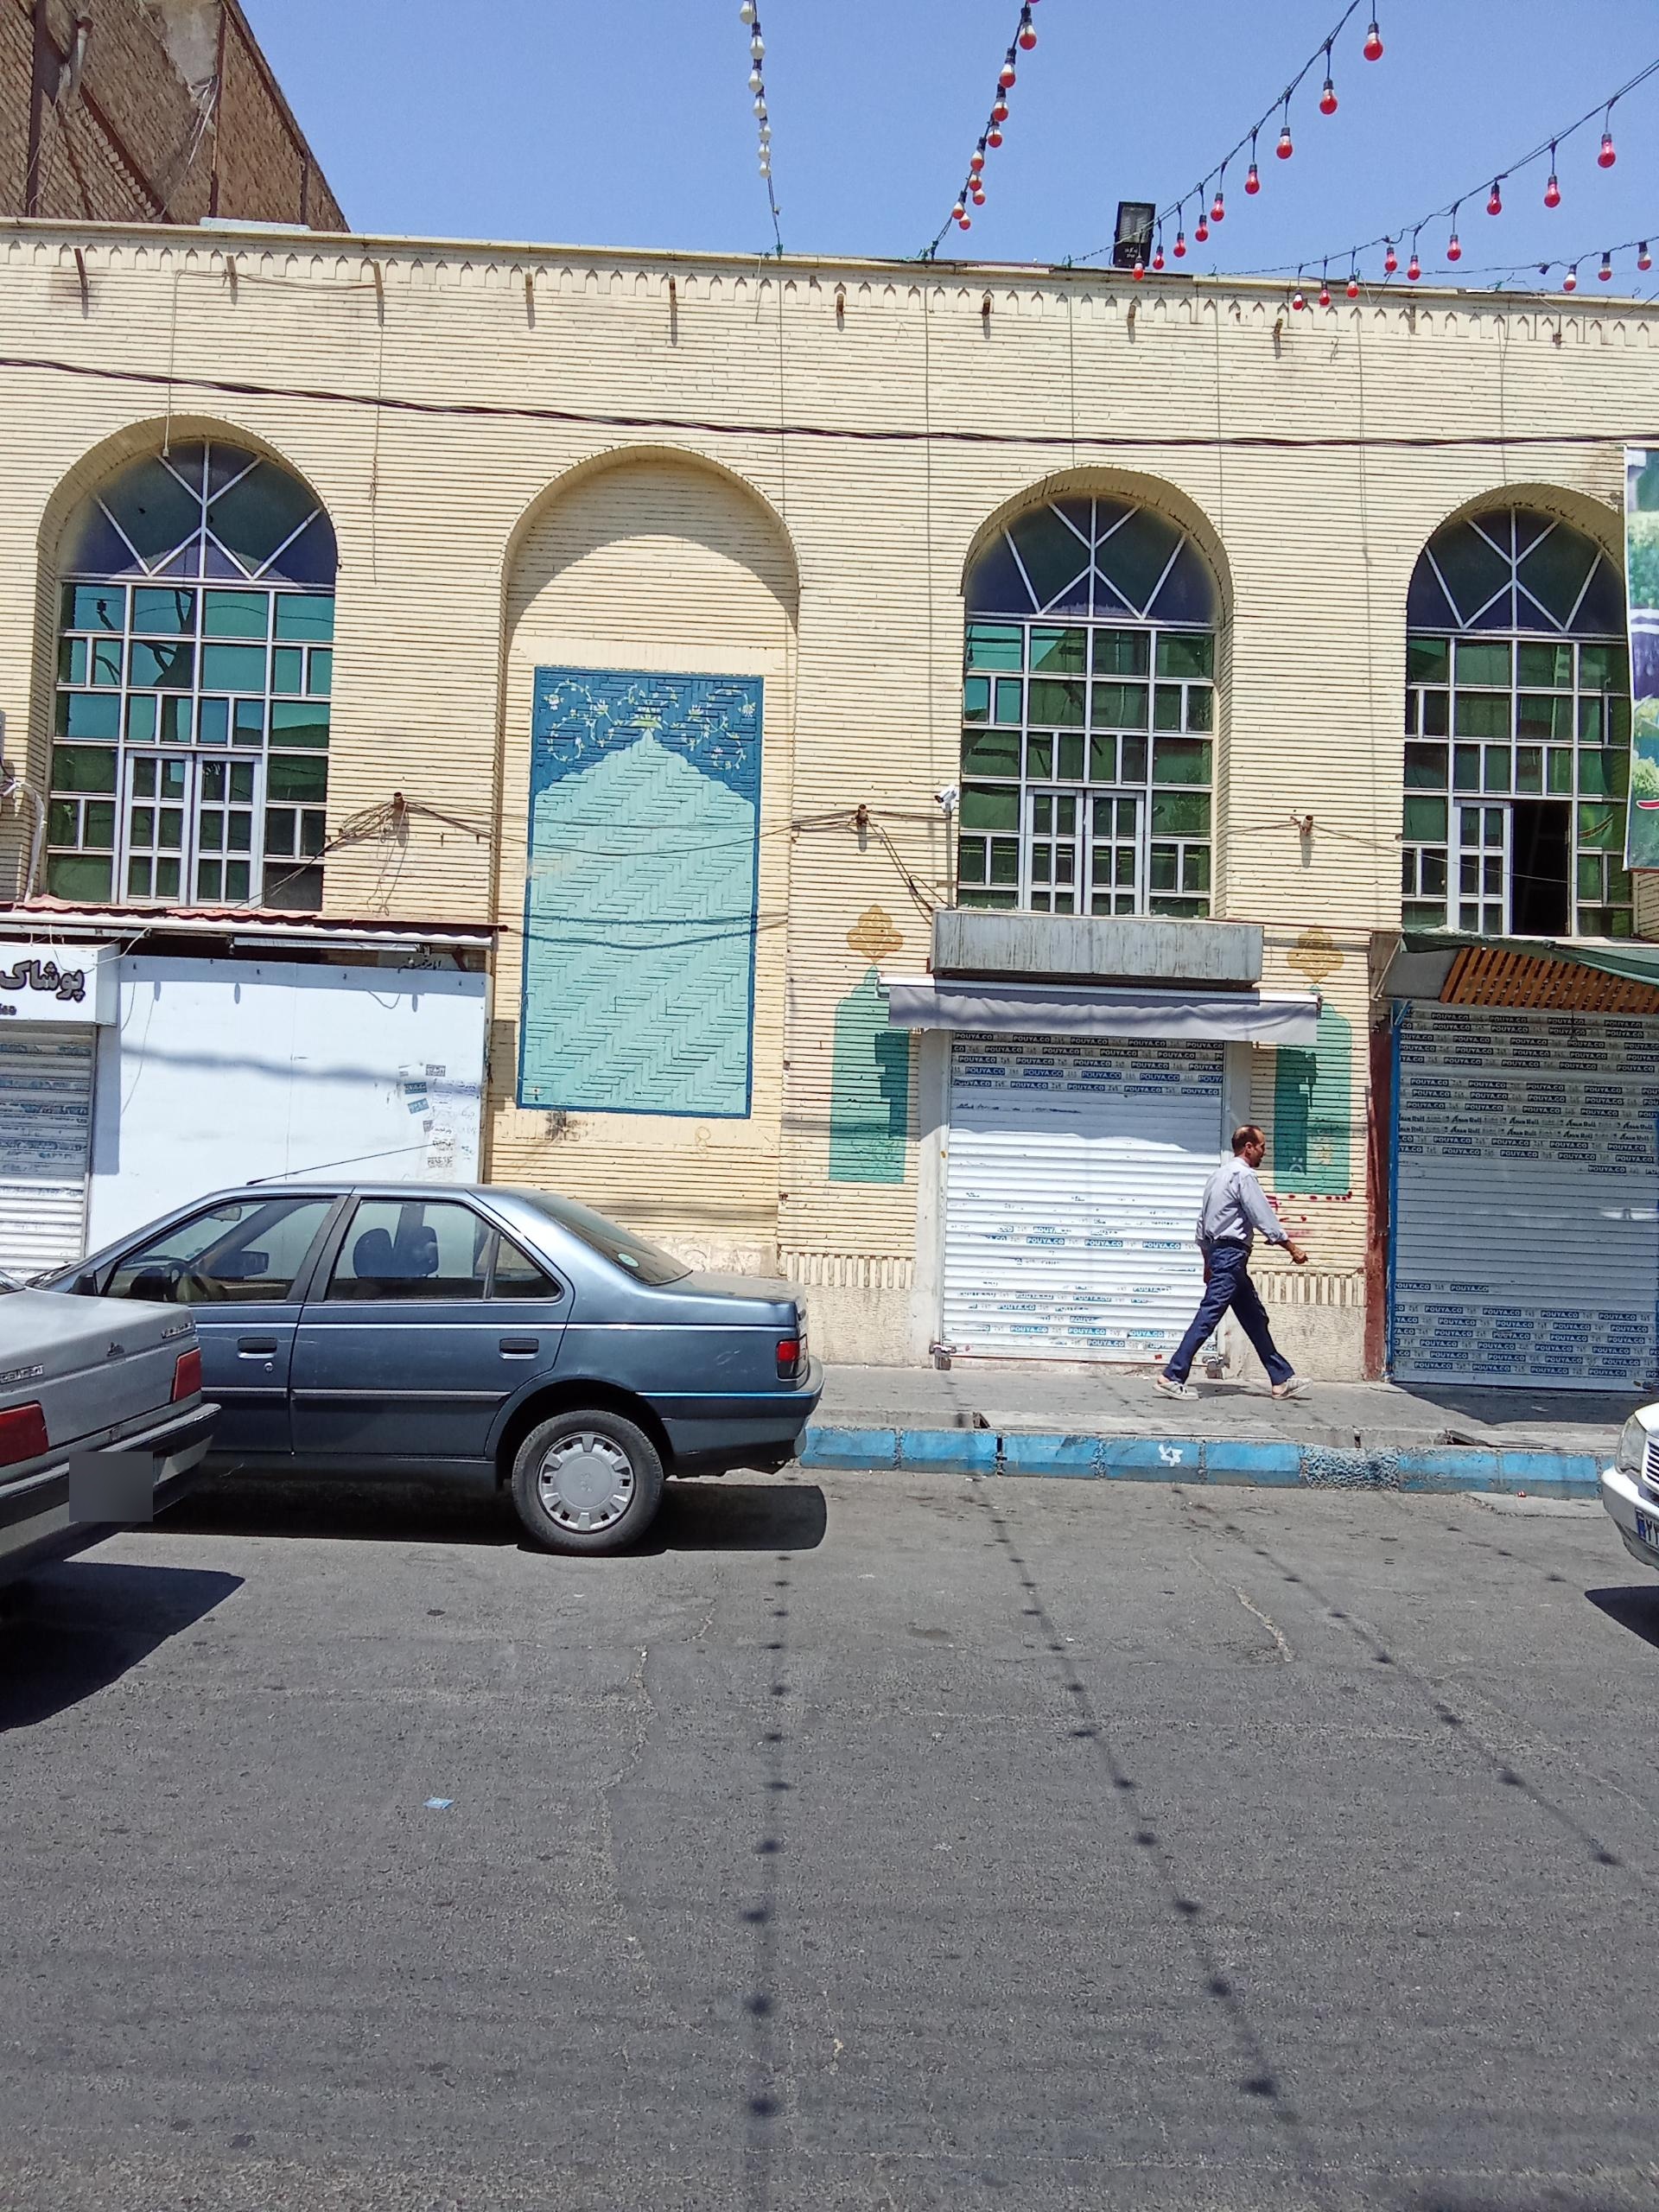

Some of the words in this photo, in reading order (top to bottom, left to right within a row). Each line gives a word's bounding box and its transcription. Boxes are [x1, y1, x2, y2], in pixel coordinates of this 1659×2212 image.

[0, 959, 86, 1003] پوشاک
[1186, 1041, 1224, 1050] POUYA.CO
[1158, 1051, 1195, 1059] POUYA.CO
[959, 1055, 996, 1064] POUYA.CO
[1016, 1057, 1054, 1065] POUYA.CO
[1131, 1061, 1169, 1070] POUYA.CO
[1024, 1069, 1063, 1077] POUYA.CO
[1011, 1081, 1048, 1090] POUYA.CO
[1181, 1087, 1219, 1096] POUYA.CO
